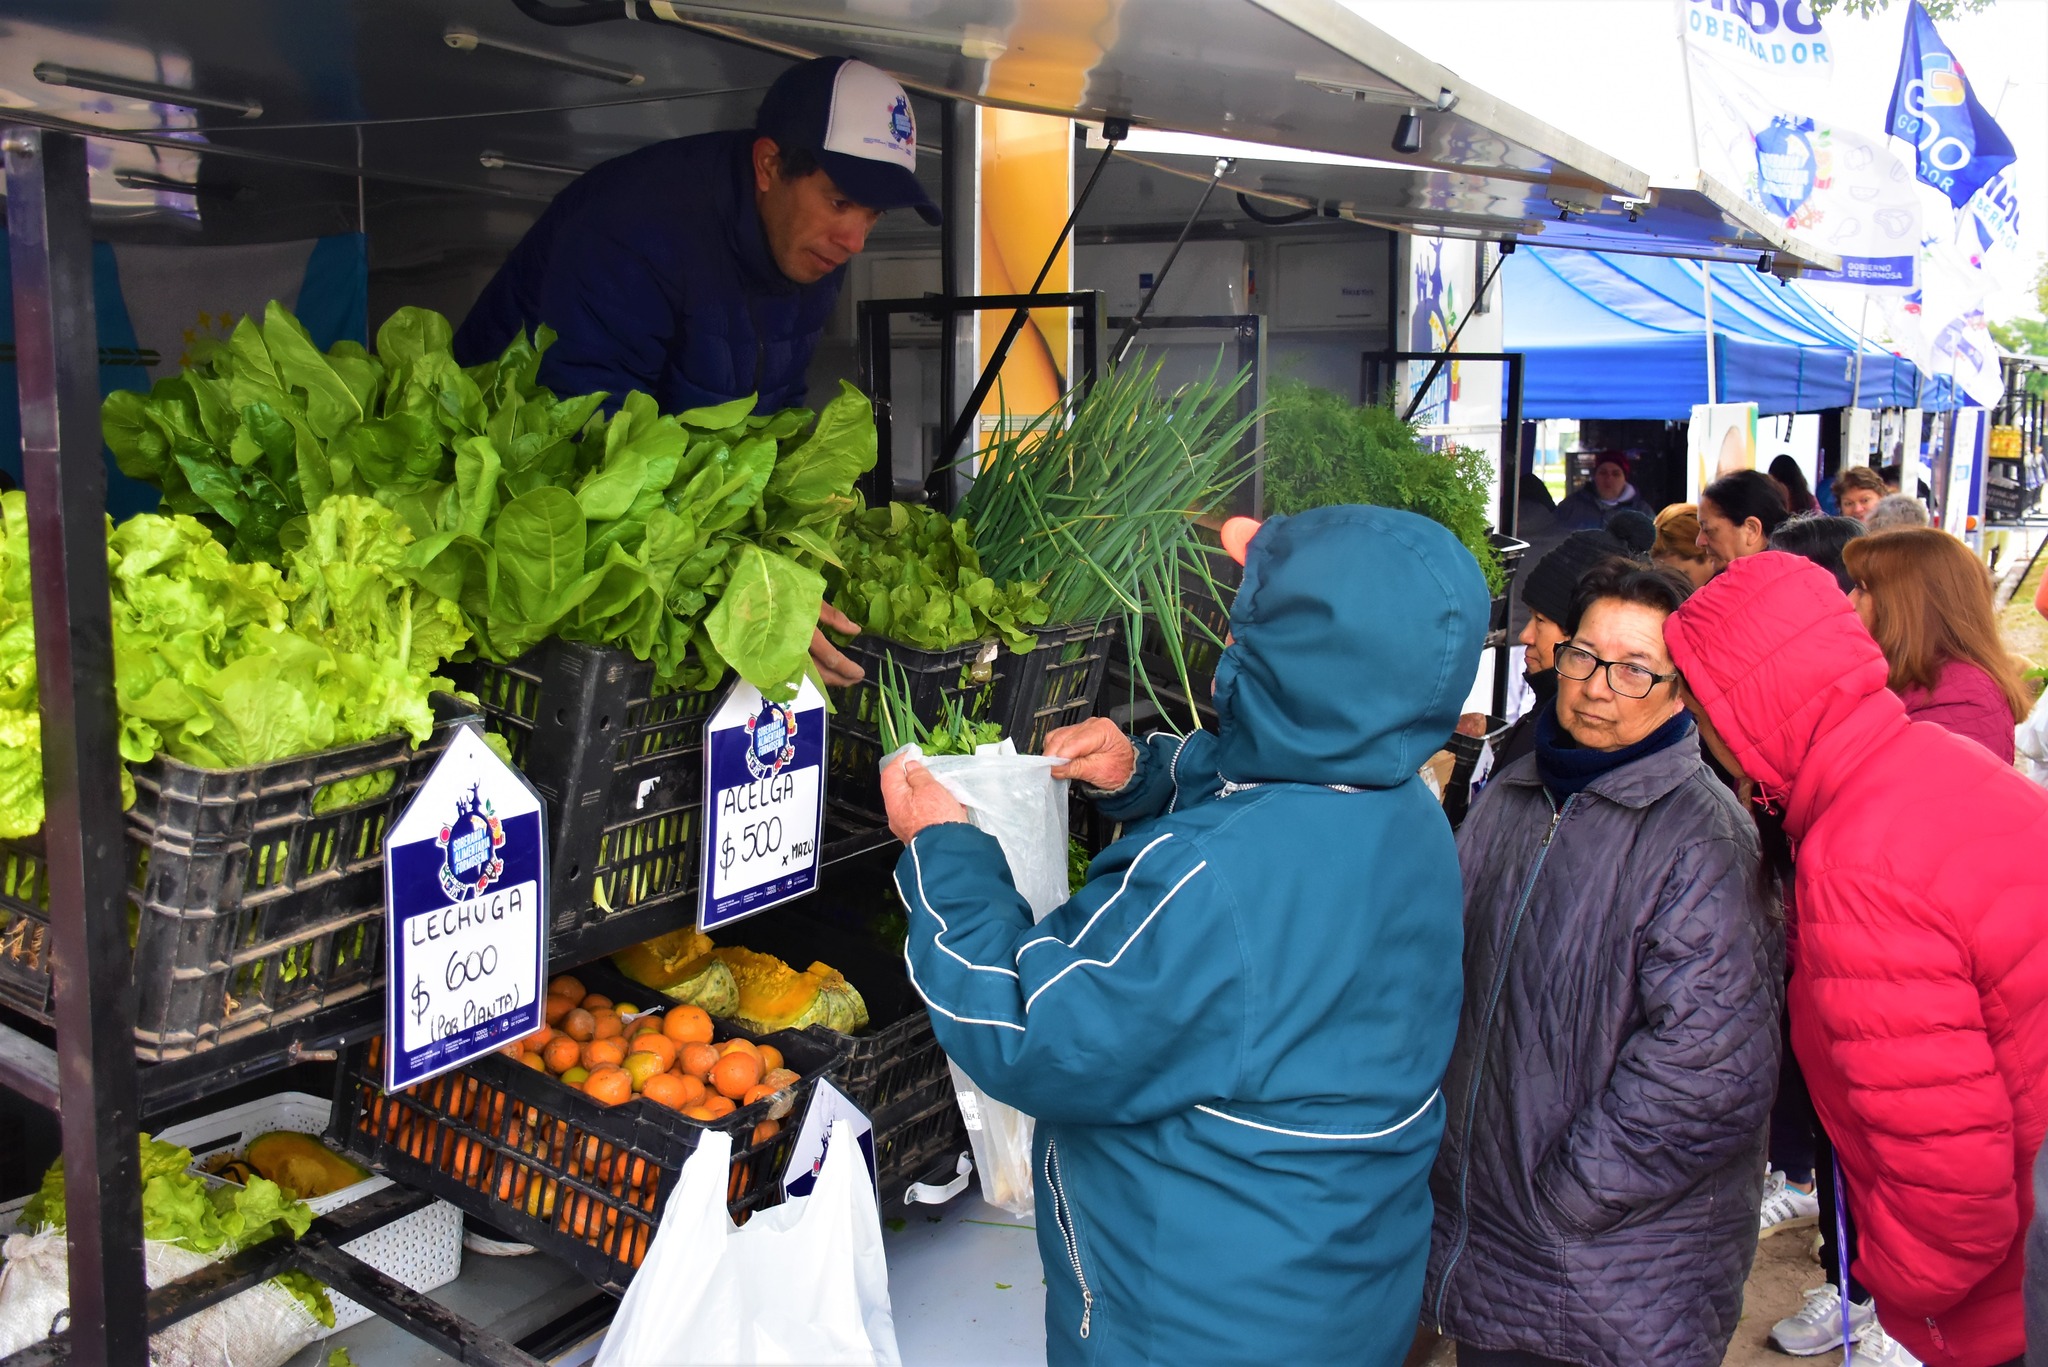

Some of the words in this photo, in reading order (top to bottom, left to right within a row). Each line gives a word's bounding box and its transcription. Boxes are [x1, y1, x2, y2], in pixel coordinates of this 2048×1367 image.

[1847, 262, 1892, 272] GOBIERNO
[1847, 270, 1860, 278] DE
[1861, 271, 1903, 280] FORMOSA
[723, 774, 794, 816] ACELGA
[719, 831, 736, 881] $
[741, 816, 782, 862] 500
[412, 888, 522, 946] LECHUGA
[411, 973, 430, 1026] $
[446, 944, 498, 991] 600
